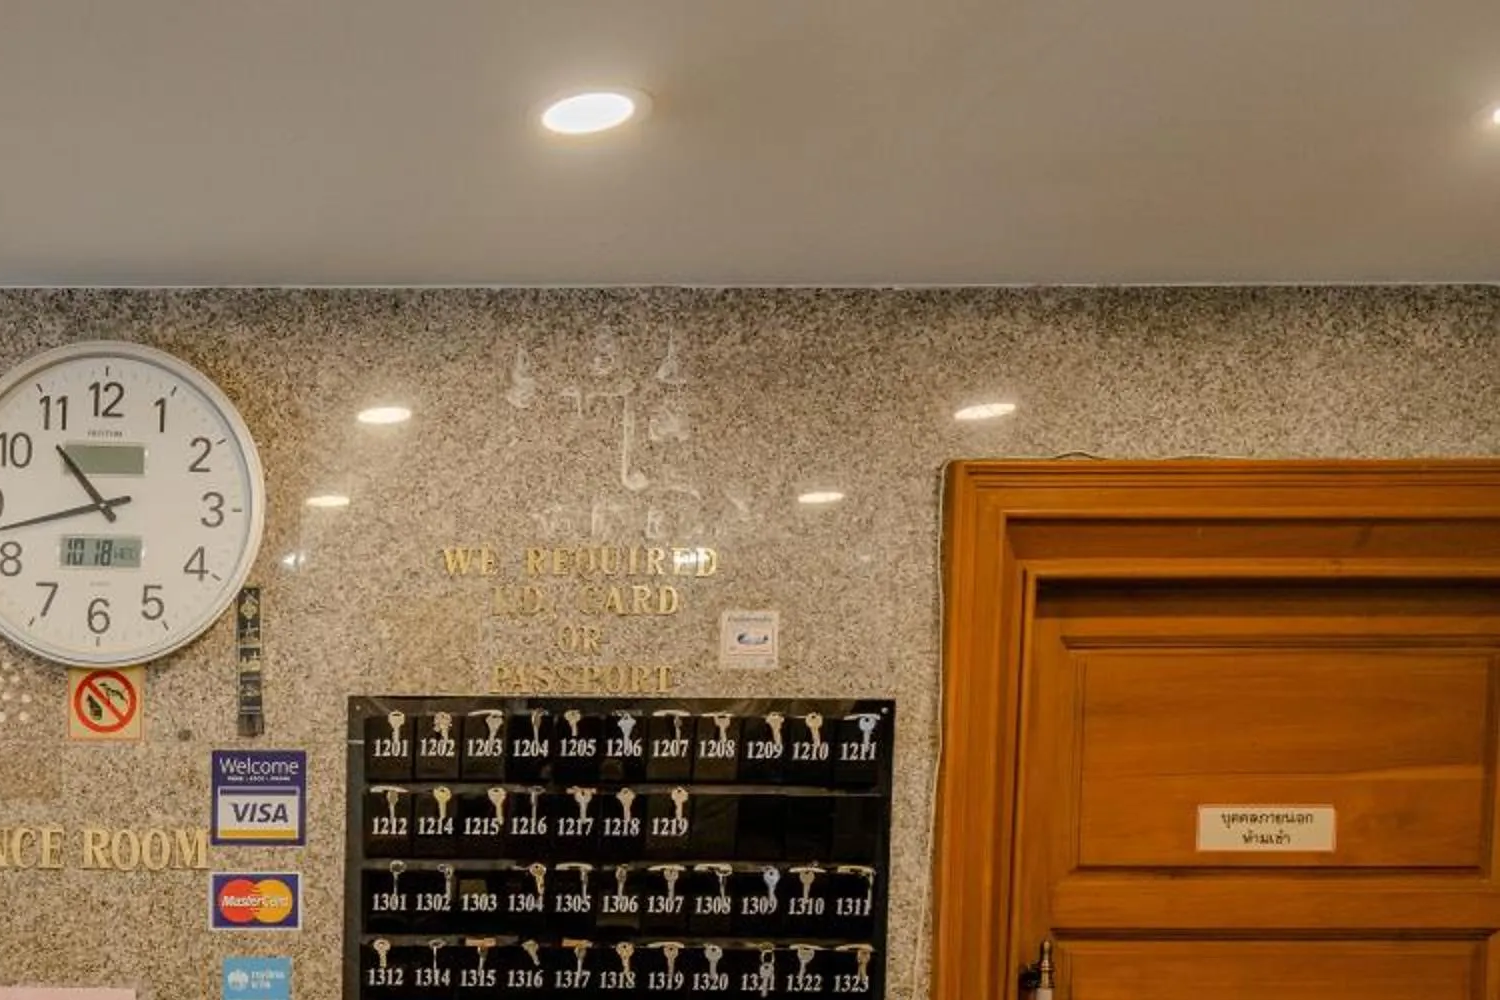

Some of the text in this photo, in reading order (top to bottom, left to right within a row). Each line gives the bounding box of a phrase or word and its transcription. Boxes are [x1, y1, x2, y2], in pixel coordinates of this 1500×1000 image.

[39, 395, 68, 431] 11
[89, 382, 125, 418] 12
[153, 398, 167, 433] 1
[189, 437, 212, 473] 2
[201, 492, 225, 527] 3
[0, 541, 23, 577] 8
[183, 547, 209, 582] 4
[443, 546, 718, 578] WE REQUIRED
[36, 582, 59, 617] 7
[142, 585, 165, 621] 5
[580, 585, 680, 616] CARD
[87, 598, 111, 634] 6
[557, 624, 602, 655] OR
[490, 665, 675, 694] PASSPORT
[374, 739, 877, 760] 1201 1202 1203 1204 1205 1206 1207 1208 1209 1210 1211
[219, 757, 299, 775] Welcome
[231, 803, 289, 823] VISA
[372, 817, 689, 836] 1212 1214 1215 1216 1217 1218 1219
[1221, 812, 1314, 829] บุคคลภายนอก
[81, 827, 211, 871] ROOM
[1242, 829, 1291, 845] ห้ามเข้า
[372, 893, 872, 916] 1301 1302 1303 1304 1305 1306 1307 1308 1309 1310 1311
[369, 969, 404, 987] 1312
[415, 969, 450, 987] 1314
[460, 969, 496, 987] 1315
[507, 970, 544, 988] 1316
[555, 970, 591, 988] 1317
[599, 971, 636, 989] 1318
[647, 972, 684, 990] 1319
[692, 973, 729, 991] 1320
[786, 974, 823, 992] 1322
[833, 975, 870, 993] 1323
